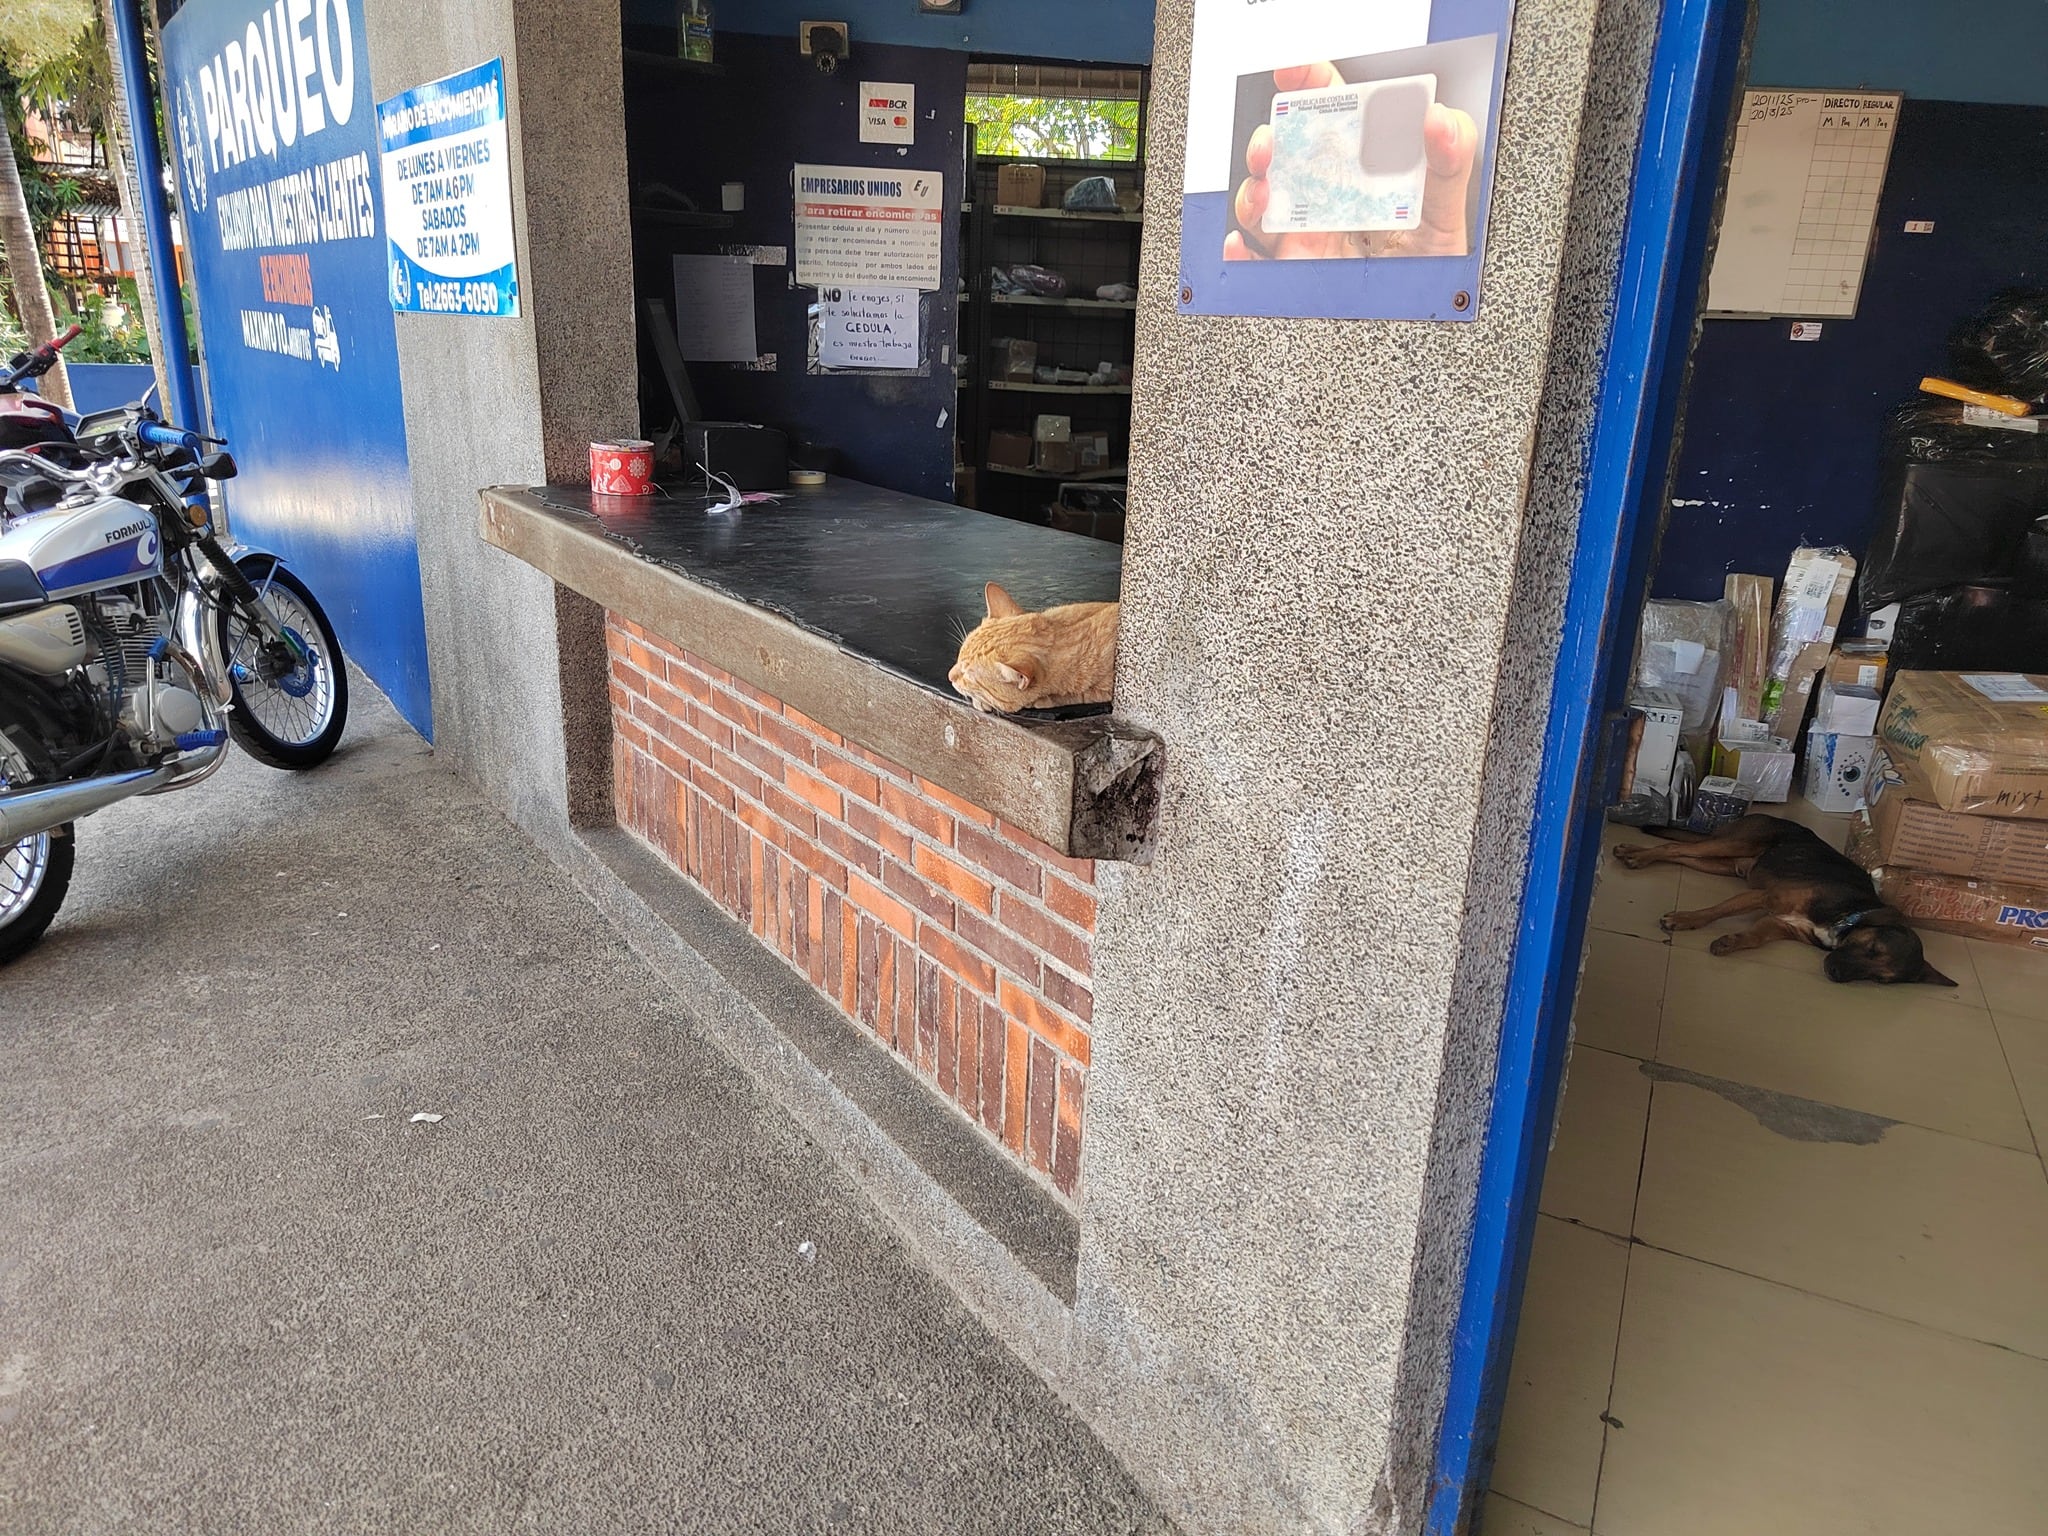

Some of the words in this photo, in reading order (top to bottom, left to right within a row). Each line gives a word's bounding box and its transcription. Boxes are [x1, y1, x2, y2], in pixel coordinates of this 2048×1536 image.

[200, 0, 354, 175] PARQUEO
[413, 103, 427, 127] DE
[427, 79, 500, 124] ENCOMIENDAS
[889, 100, 907, 109] BCR
[1326, 95, 1345, 103] COSTA
[1345, 93, 1359, 101] RICA
[1824, 96, 1860, 109] DIRECTO
[1862, 98, 1895, 110] REGULAR
[1750, 105, 1795, 121] 20/3/25
[868, 117, 886, 126] VISA
[1822, 117, 1833, 128] M
[1859, 117, 1870, 128] M
[398, 158, 408, 181] DE
[408, 150, 436, 178] LUNES
[437, 149, 445, 173] A
[445, 138, 491, 170] VIERNES
[412, 181, 424, 205] DE
[424, 178, 443, 204] 7AM
[446, 177, 453, 201] A
[801, 177, 865, 196] EMPRESARIOS
[867, 180, 902, 198] UNIDOS
[217, 188, 254, 251] EXCLUSIVO
[248, 183, 275, 249] PARA
[268, 167, 319, 248] NUESTROS
[315, 150, 375, 243] CLIENTES
[422, 204, 467, 232] SABADOS
[828, 207, 863, 217] retirar
[797, 222, 830, 231] Presentar
[832, 224, 855, 232] cédula
[878, 227, 882, 235] y
[417, 236, 429, 258] DE
[429, 235, 450, 258] 7AM
[451, 234, 459, 257] A
[459, 232, 480, 256] 2PM
[843, 237, 887, 246] encomiendas
[930, 240, 939, 248] de
[815, 248, 842, 256] persona
[826, 260, 858, 268] fotocopia
[880, 262, 903, 270] ambos
[906, 263, 925, 271] lados
[927, 263, 938, 271] del
[831, 272, 836, 280] y
[416, 280, 499, 314] Tel:2663-6050
[823, 287, 842, 303] NO
[841, 307, 889, 319] solicitamos
[894, 309, 905, 320] la
[240, 309, 277, 353] MAXIMO
